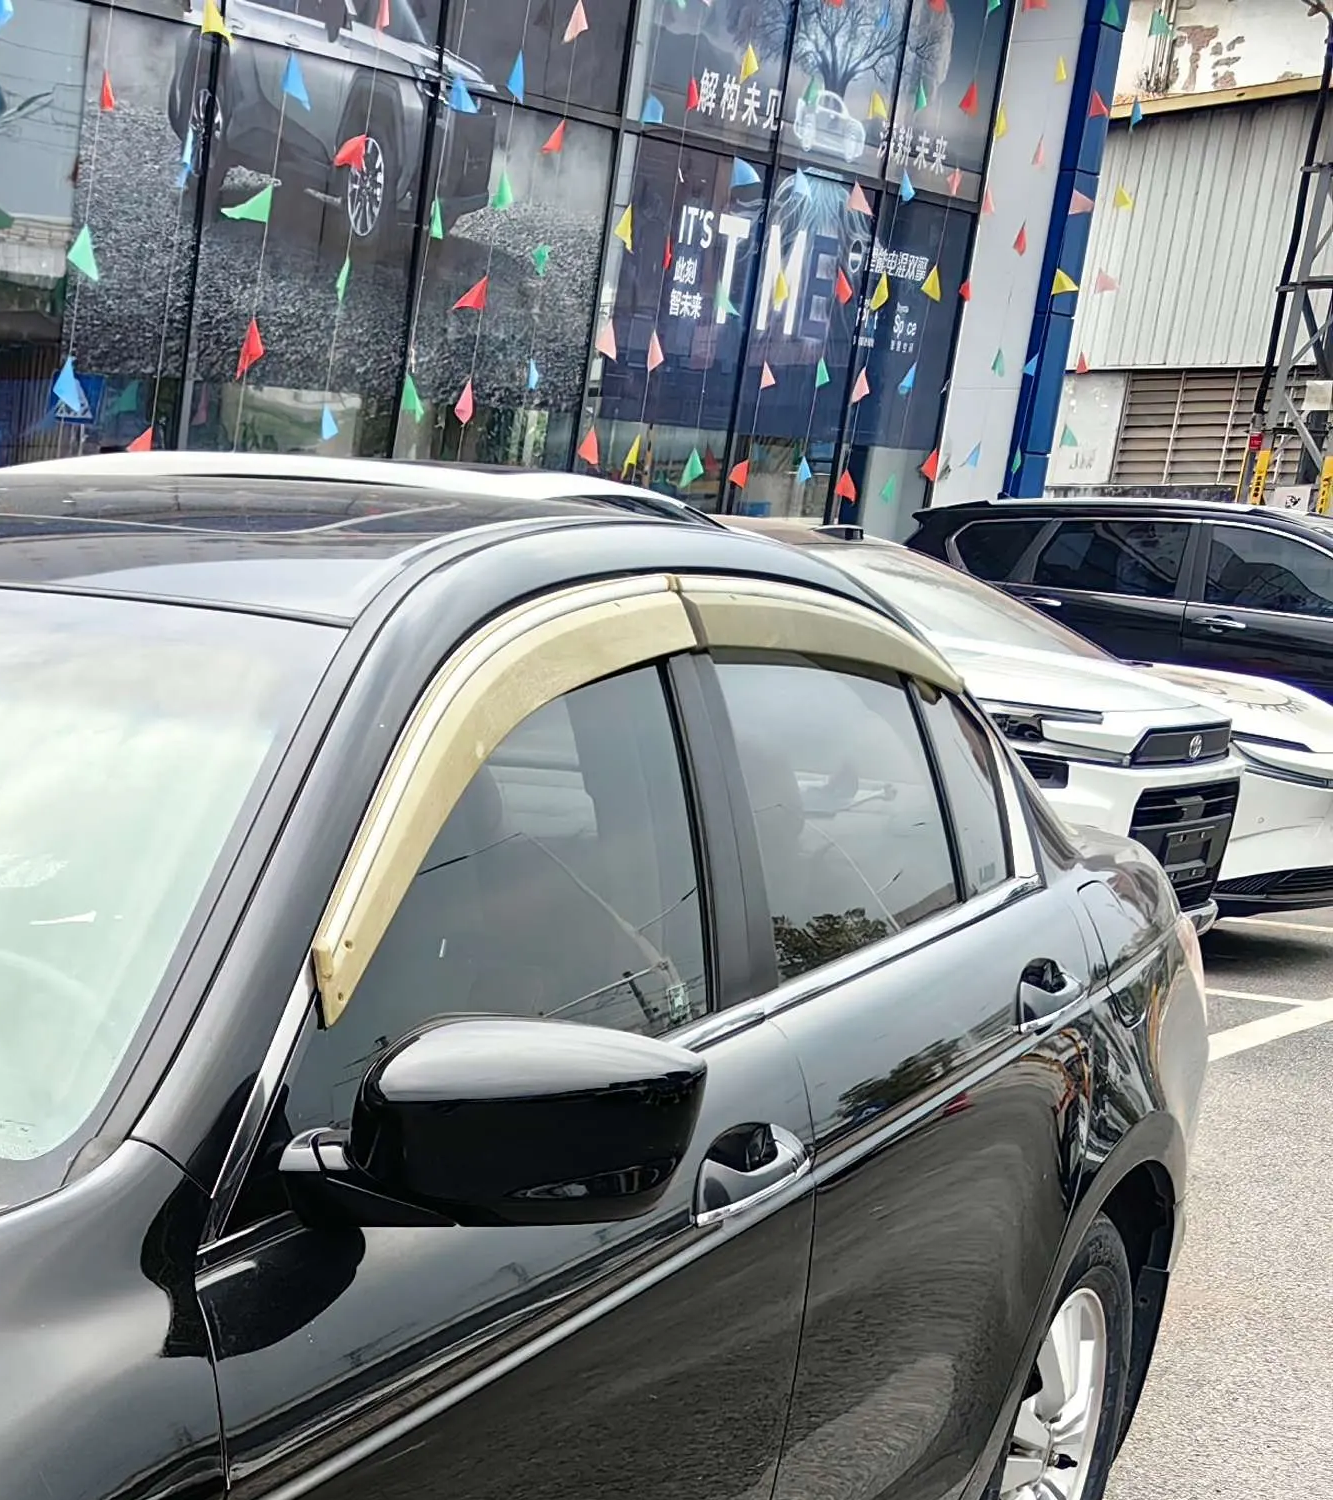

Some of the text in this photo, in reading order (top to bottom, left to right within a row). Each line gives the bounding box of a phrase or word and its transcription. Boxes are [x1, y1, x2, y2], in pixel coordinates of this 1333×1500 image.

[697, 68, 783, 131] 解构未见
[673, 256, 698, 285] 此刻
[678, 205, 715, 249] IT'S
[717, 214, 840, 342] TME
[669, 288, 704, 319] 智未来
